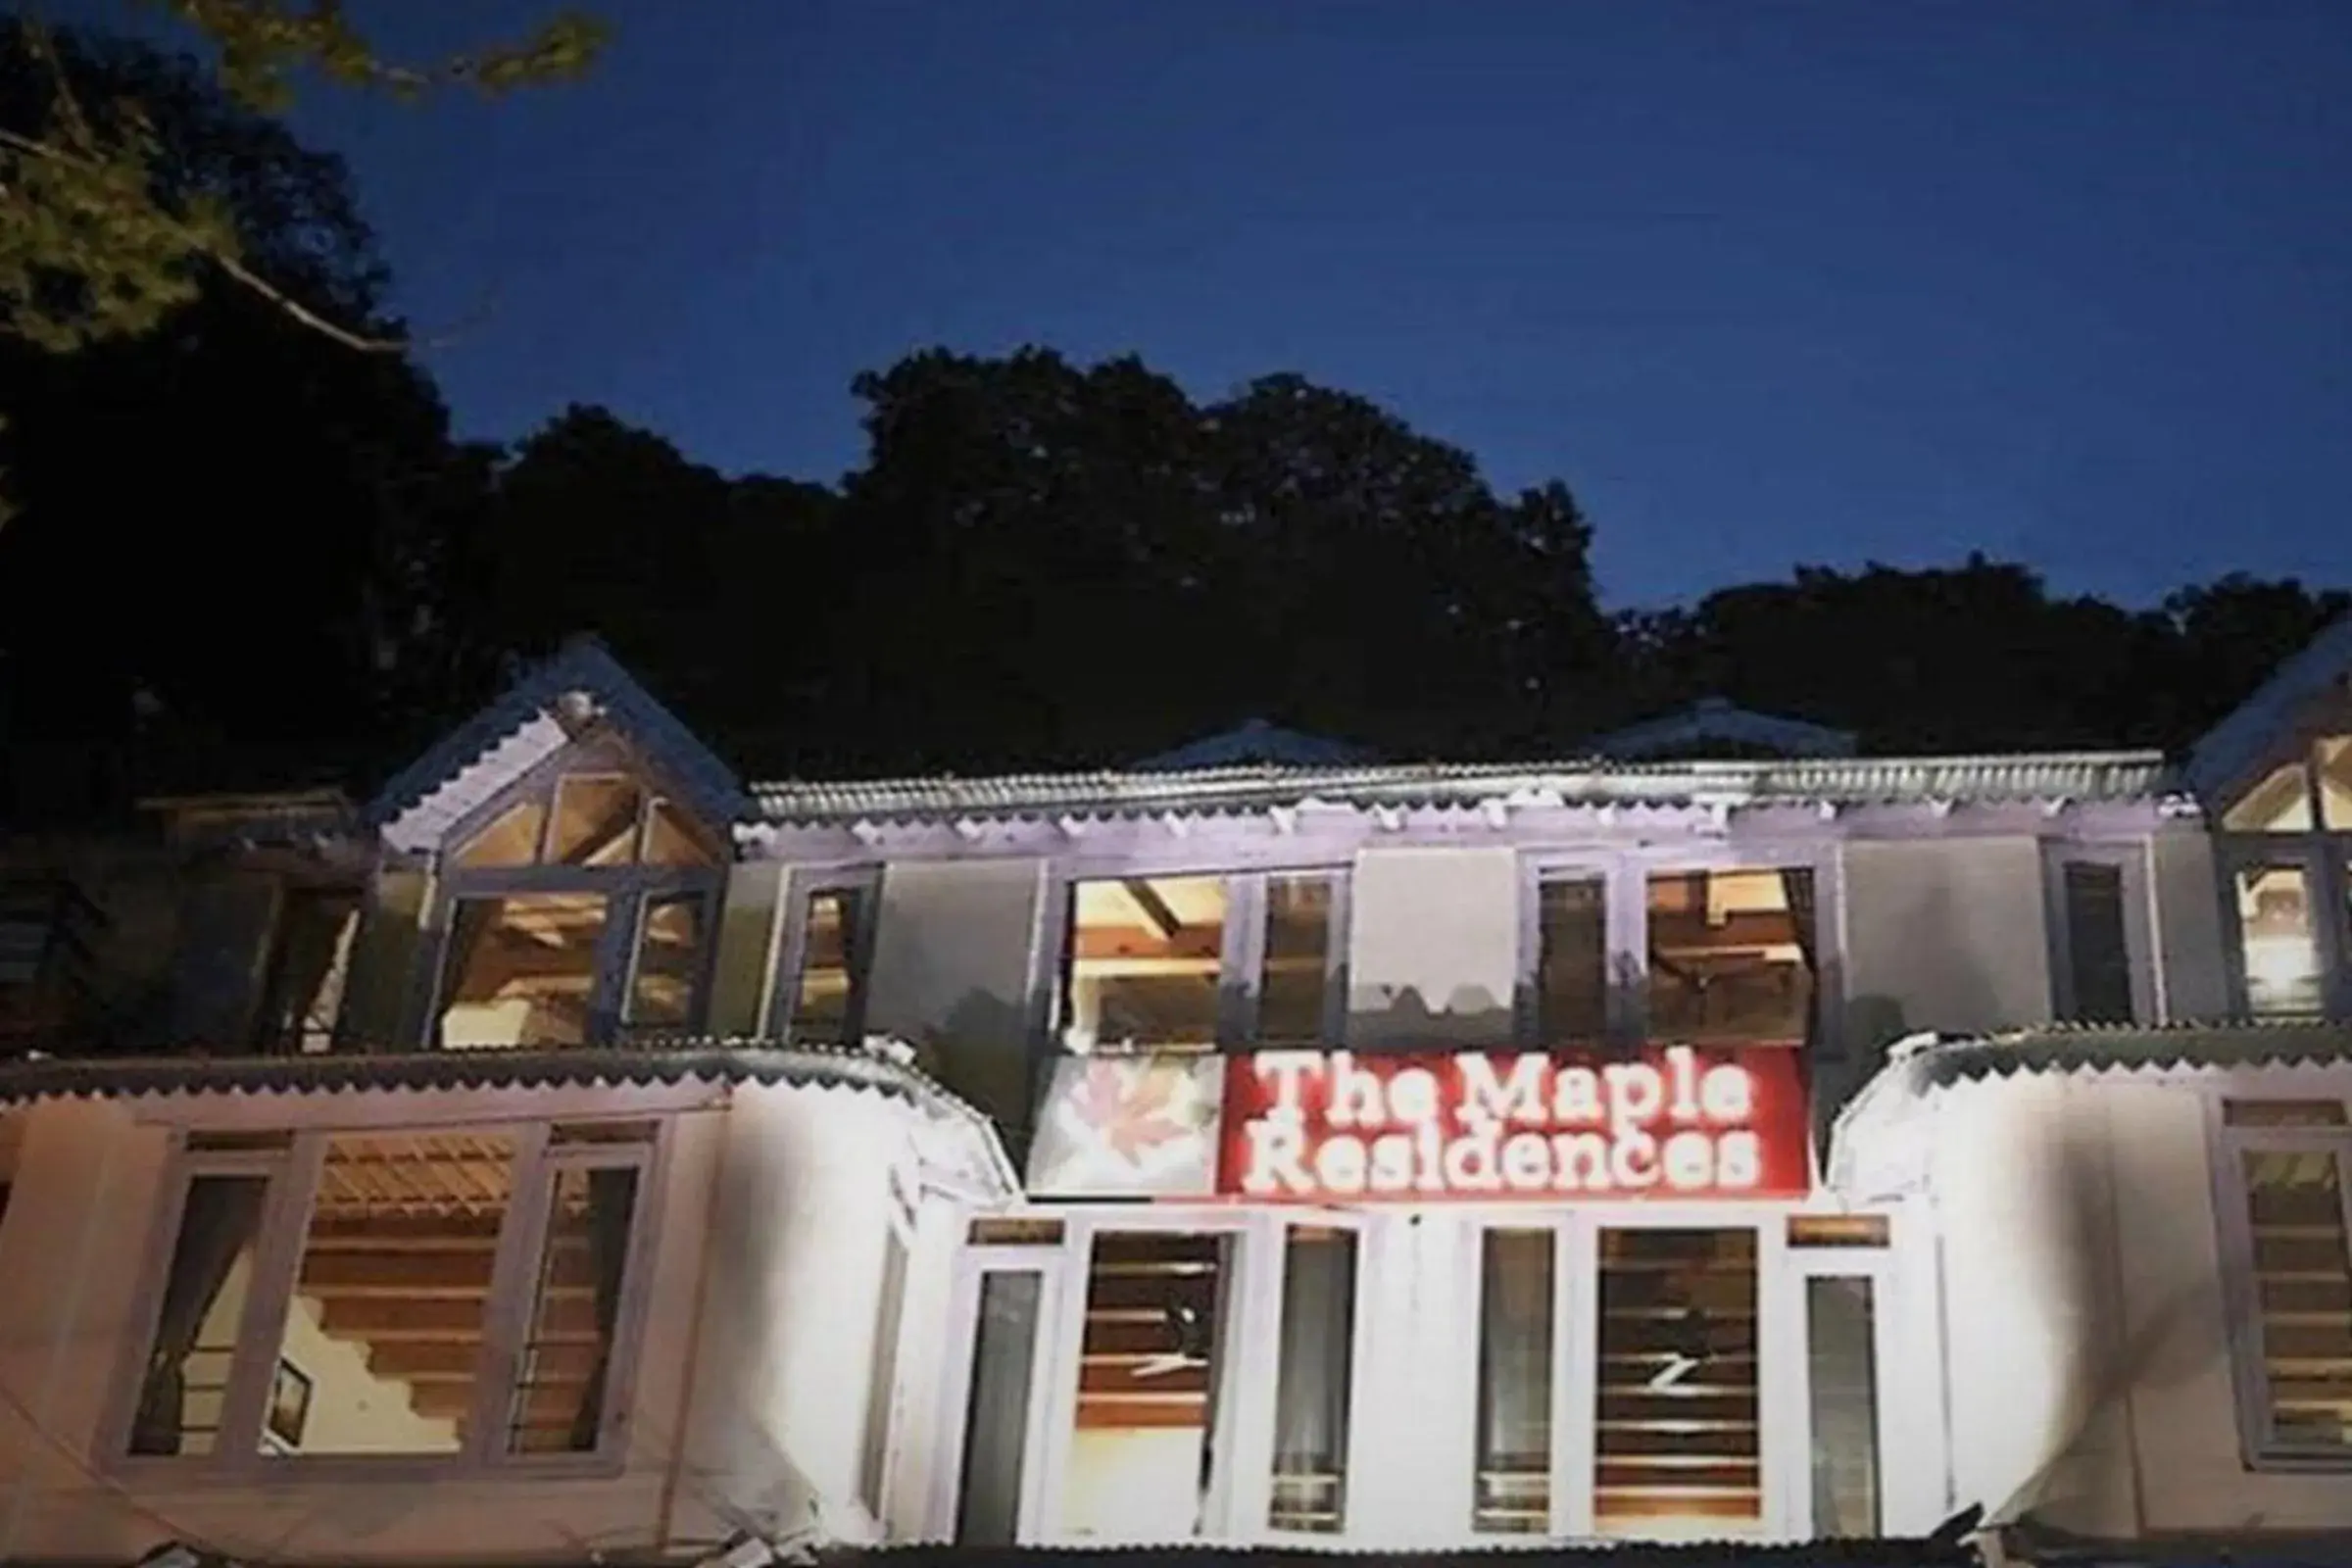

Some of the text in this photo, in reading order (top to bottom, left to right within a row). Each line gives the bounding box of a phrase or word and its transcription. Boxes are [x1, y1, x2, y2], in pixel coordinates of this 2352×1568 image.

[1252, 1046, 1753, 1140] The Maple
[1241, 1115, 1761, 1194] Residences
